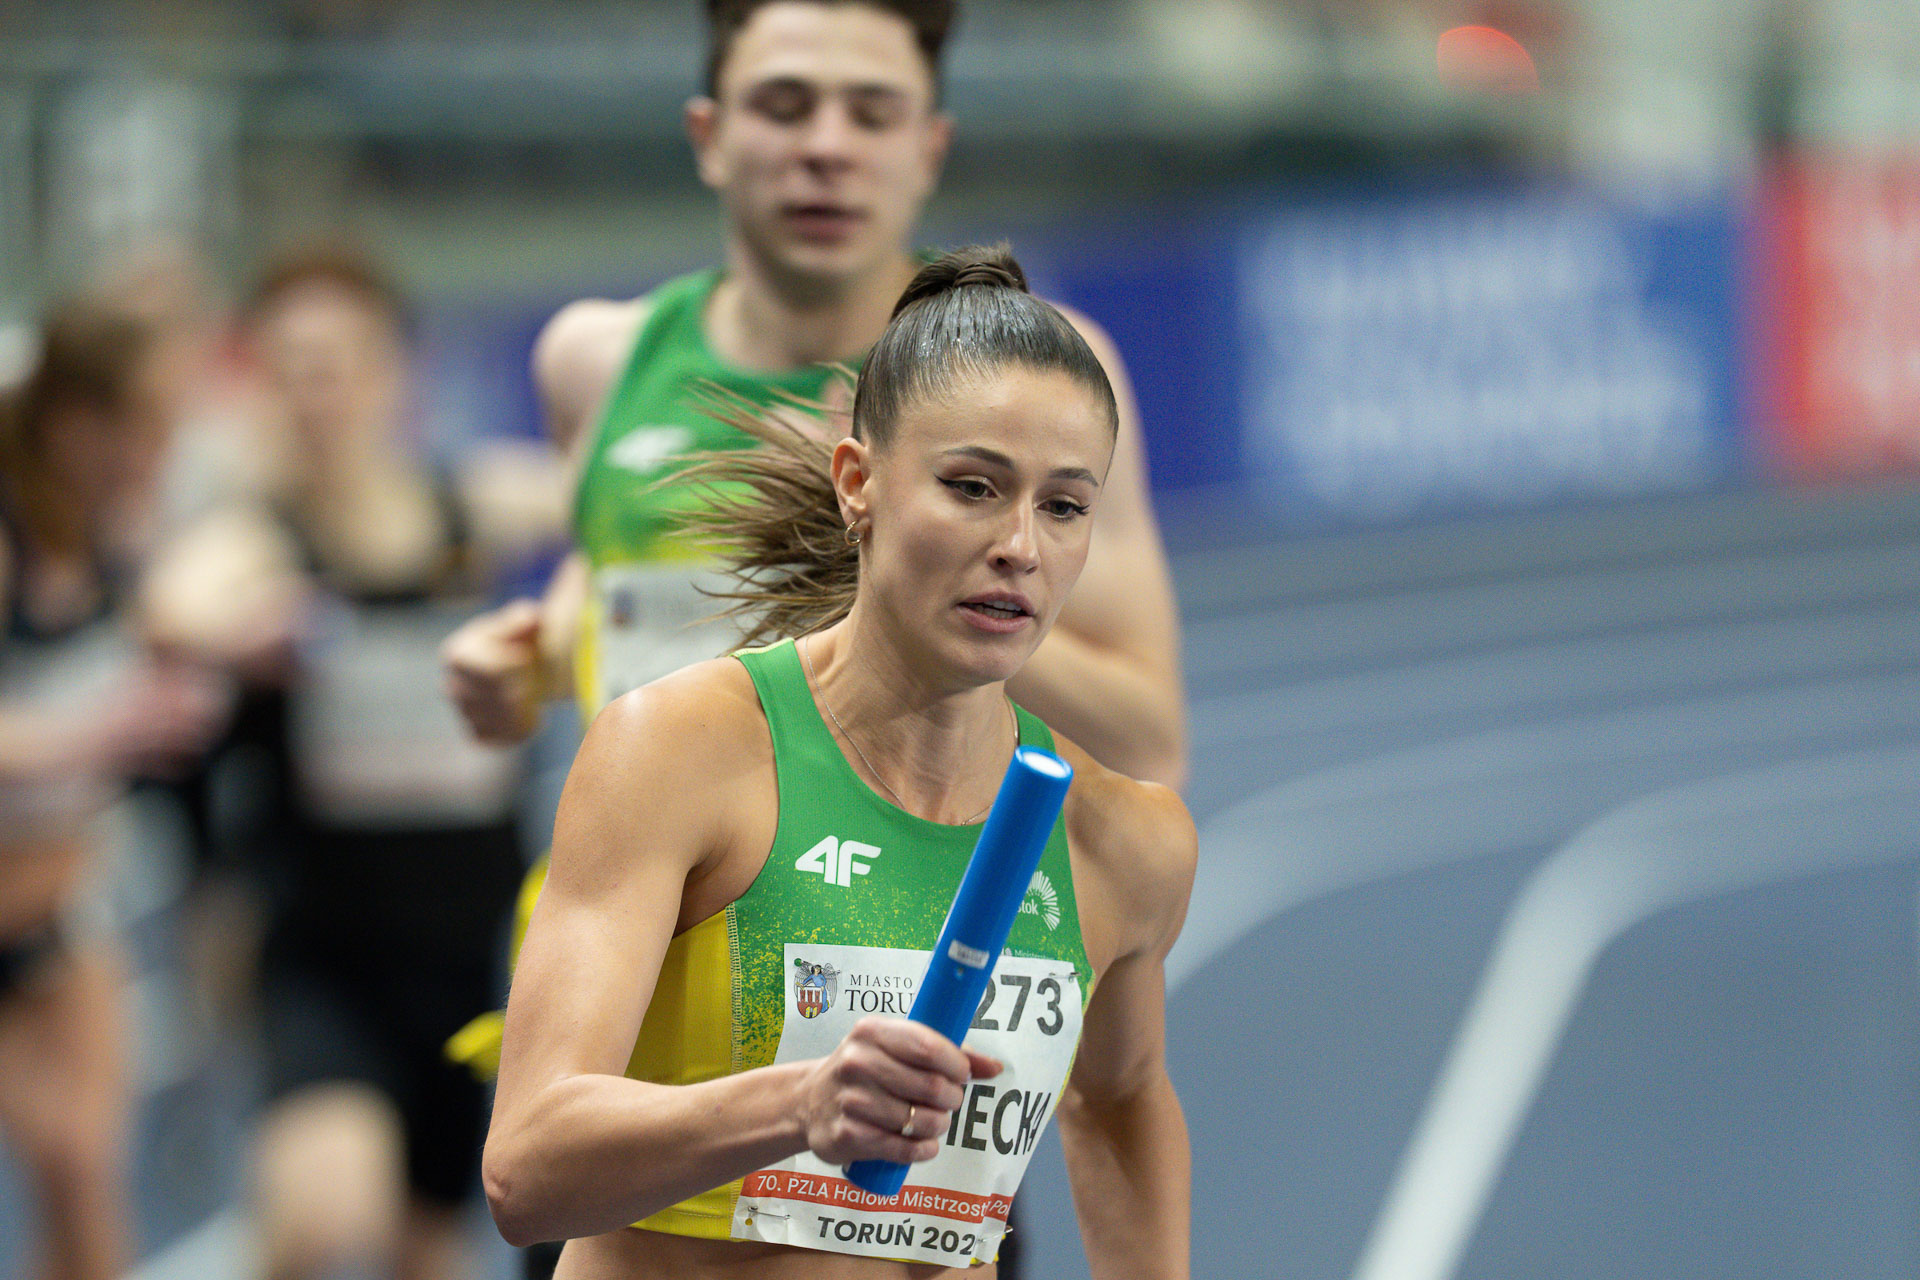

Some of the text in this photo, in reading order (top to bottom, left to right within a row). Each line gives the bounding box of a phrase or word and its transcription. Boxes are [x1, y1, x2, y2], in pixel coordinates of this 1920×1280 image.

[795, 835, 882, 887] 4F
[845, 989, 915, 1014] TORU
[850, 974, 913, 989] MIASTO
[946, 1083, 1052, 1156] IECKA
[757, 1175, 781, 1191] 70.
[787, 1178, 829, 1199] PZLA
[834, 1184, 899, 1206] Halowe
[903, 1191, 991, 1217] Mistrzost
[818, 1216, 976, 1255] TORUŃ 202
